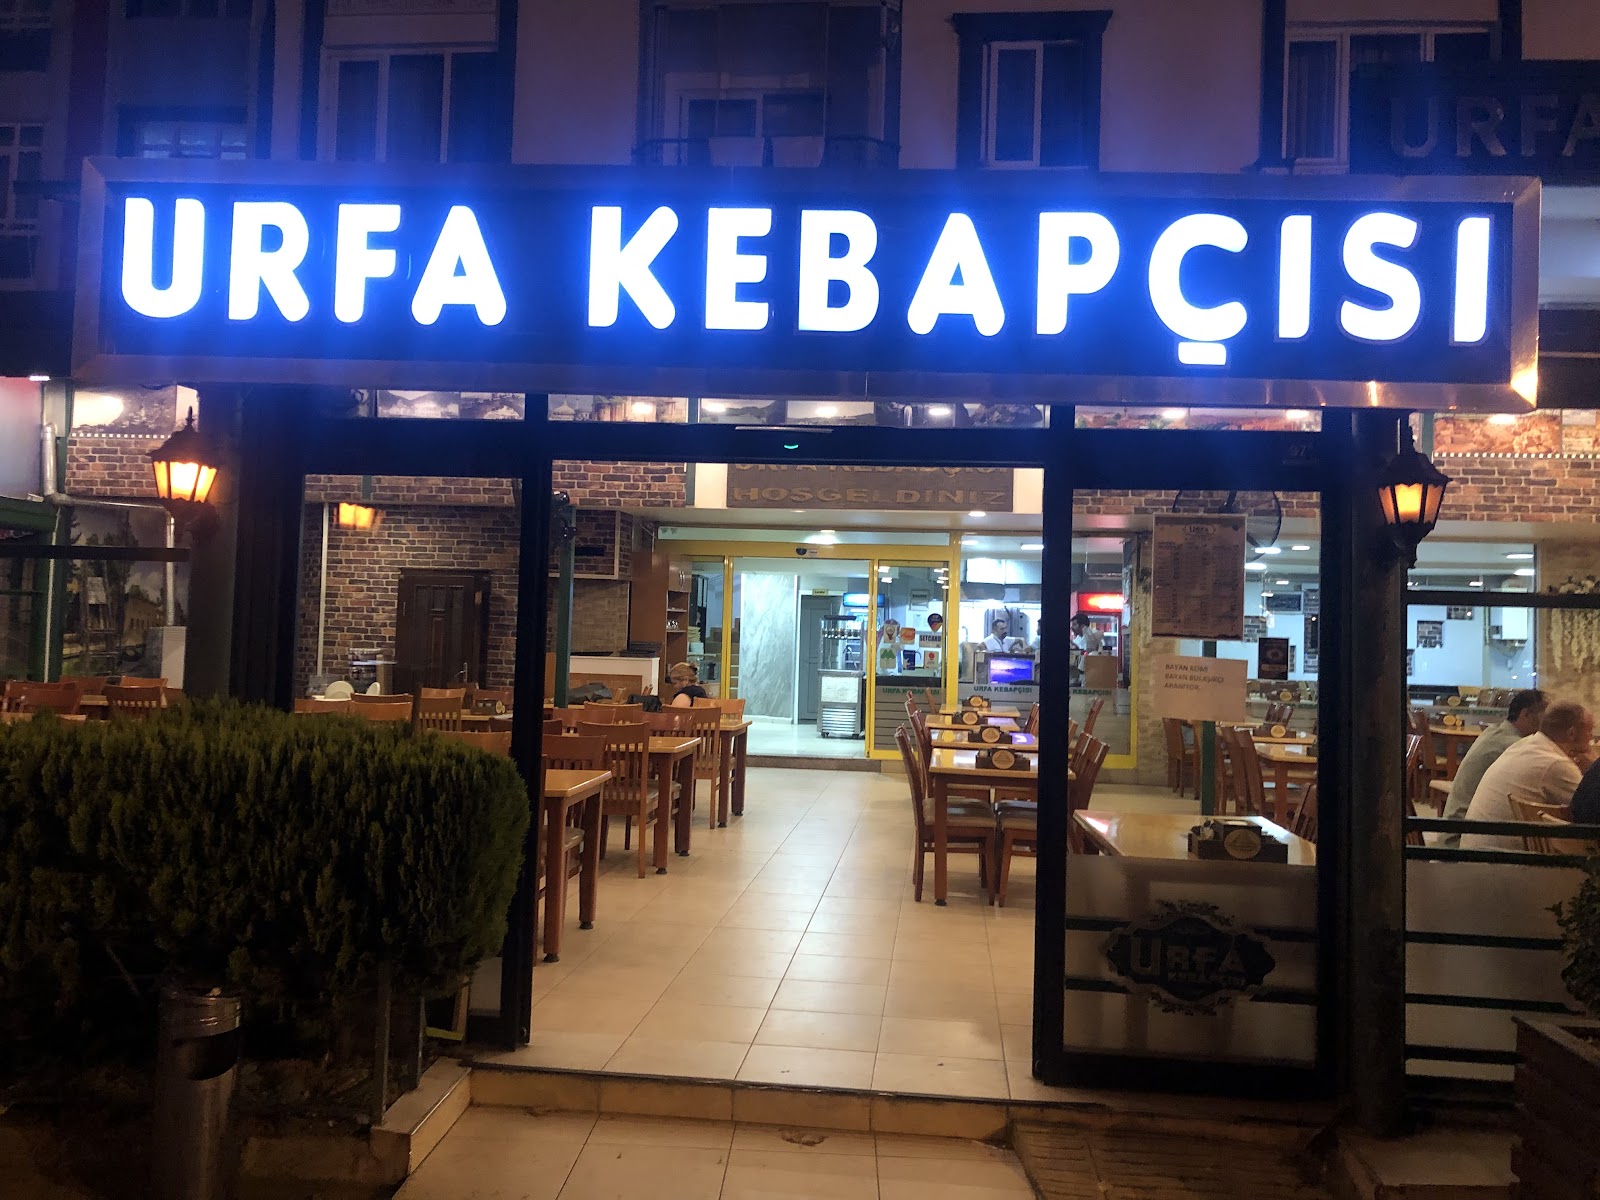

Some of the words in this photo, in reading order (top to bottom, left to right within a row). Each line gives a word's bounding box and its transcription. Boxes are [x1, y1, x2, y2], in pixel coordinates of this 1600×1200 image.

[1390, 94, 1600, 157] URFA
[121, 197, 507, 326] URFA
[587, 205, 1492, 366] KEBAPÇISI
[1164, 673, 1188, 681] BAYAN
[882, 687, 900, 695] URFA
[994, 686, 1032, 694] KEBAPÇISI
